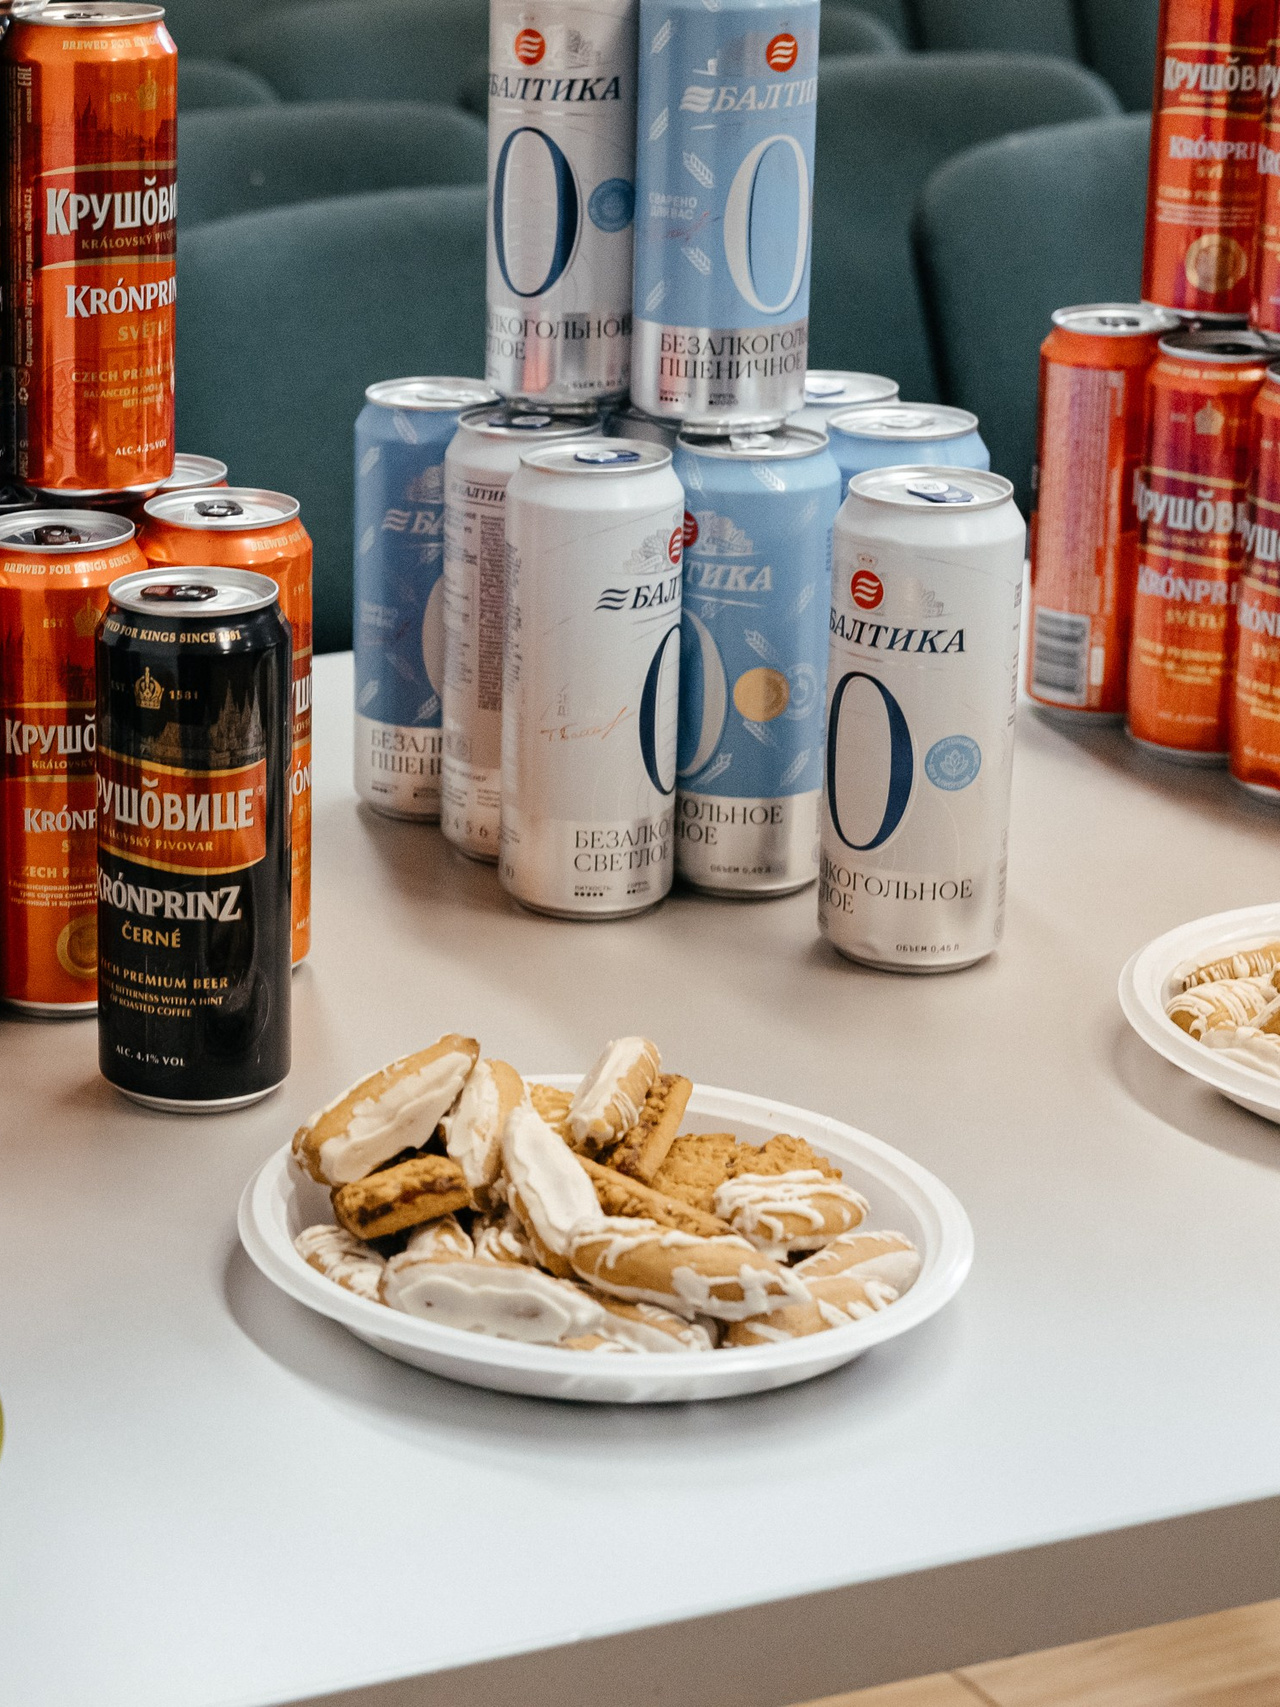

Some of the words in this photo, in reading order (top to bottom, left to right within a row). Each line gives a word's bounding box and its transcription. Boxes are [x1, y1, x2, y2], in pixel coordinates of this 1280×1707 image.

[61, 39, 109, 51] BREWED
[493, 126, 580, 299] 0
[723, 133, 810, 314] 0
[659, 350, 803, 380] ПШЕНИЧНОЕ
[3, 561, 46, 576] BREWED
[49, 562, 72, 576] FOR
[74, 560, 108, 575] KINGS
[120, 624, 138, 639] FOR
[139, 629, 176, 643] KINGS
[179, 632, 217, 644] SINCE
[218, 629, 242, 643] 1581
[826, 670, 914, 852] 0
[155, 838, 214, 853] PIVOVAR
[97, 862, 243, 923] KRÓNPRINZ
[121, 919, 182, 949] ČERNÉ
[122, 968, 188, 990] PREMIUM
[193, 976, 230, 991] BEER
[118, 997, 155, 1015] ROASTED
[156, 1006, 193, 1019] COFFEE
[161, 995, 188, 1007] WITH
[190, 997, 198, 1006] A
[199, 995, 225, 1007] HINT
[115, 1044, 134, 1058] ALC.
[135, 1050, 160, 1065] 4.1%
[162, 1055, 186, 1067] VOL
